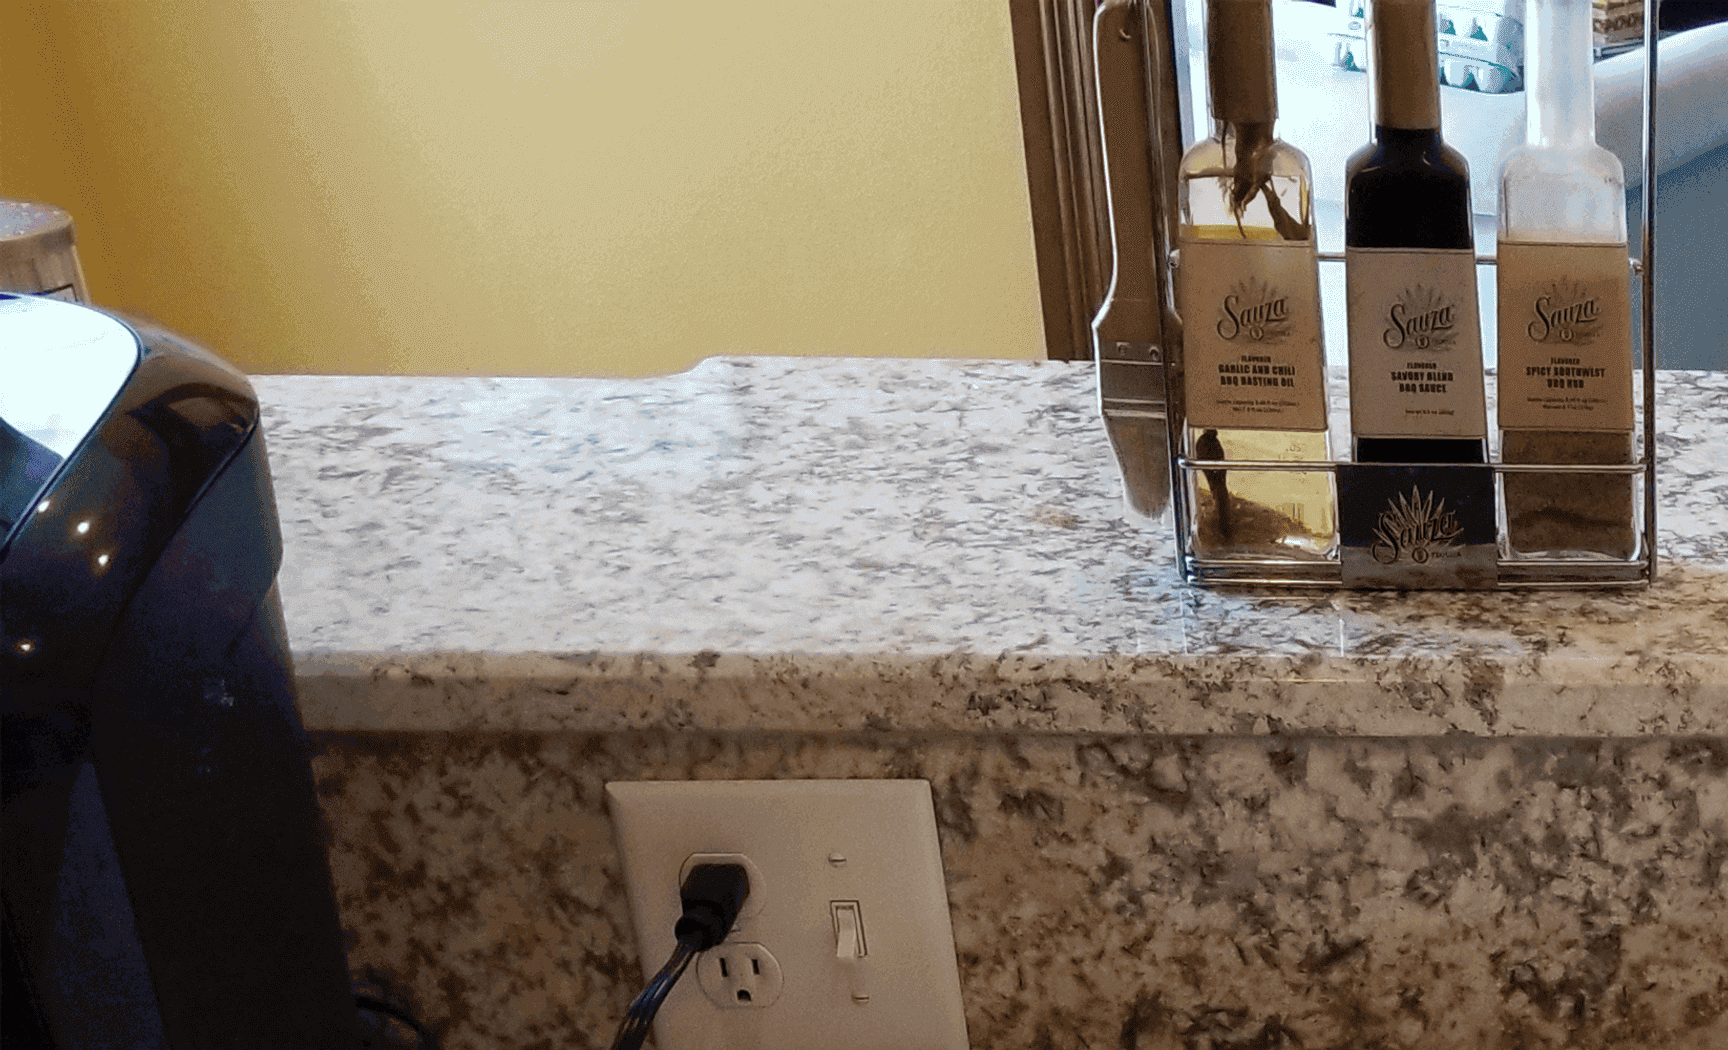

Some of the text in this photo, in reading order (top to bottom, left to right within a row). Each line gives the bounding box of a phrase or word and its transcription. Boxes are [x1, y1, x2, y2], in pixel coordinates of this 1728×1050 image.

[1217, 295, 1290, 340] Sauza
[1383, 303, 1456, 349] Sauza
[1528, 296, 1600, 342] Sauza
